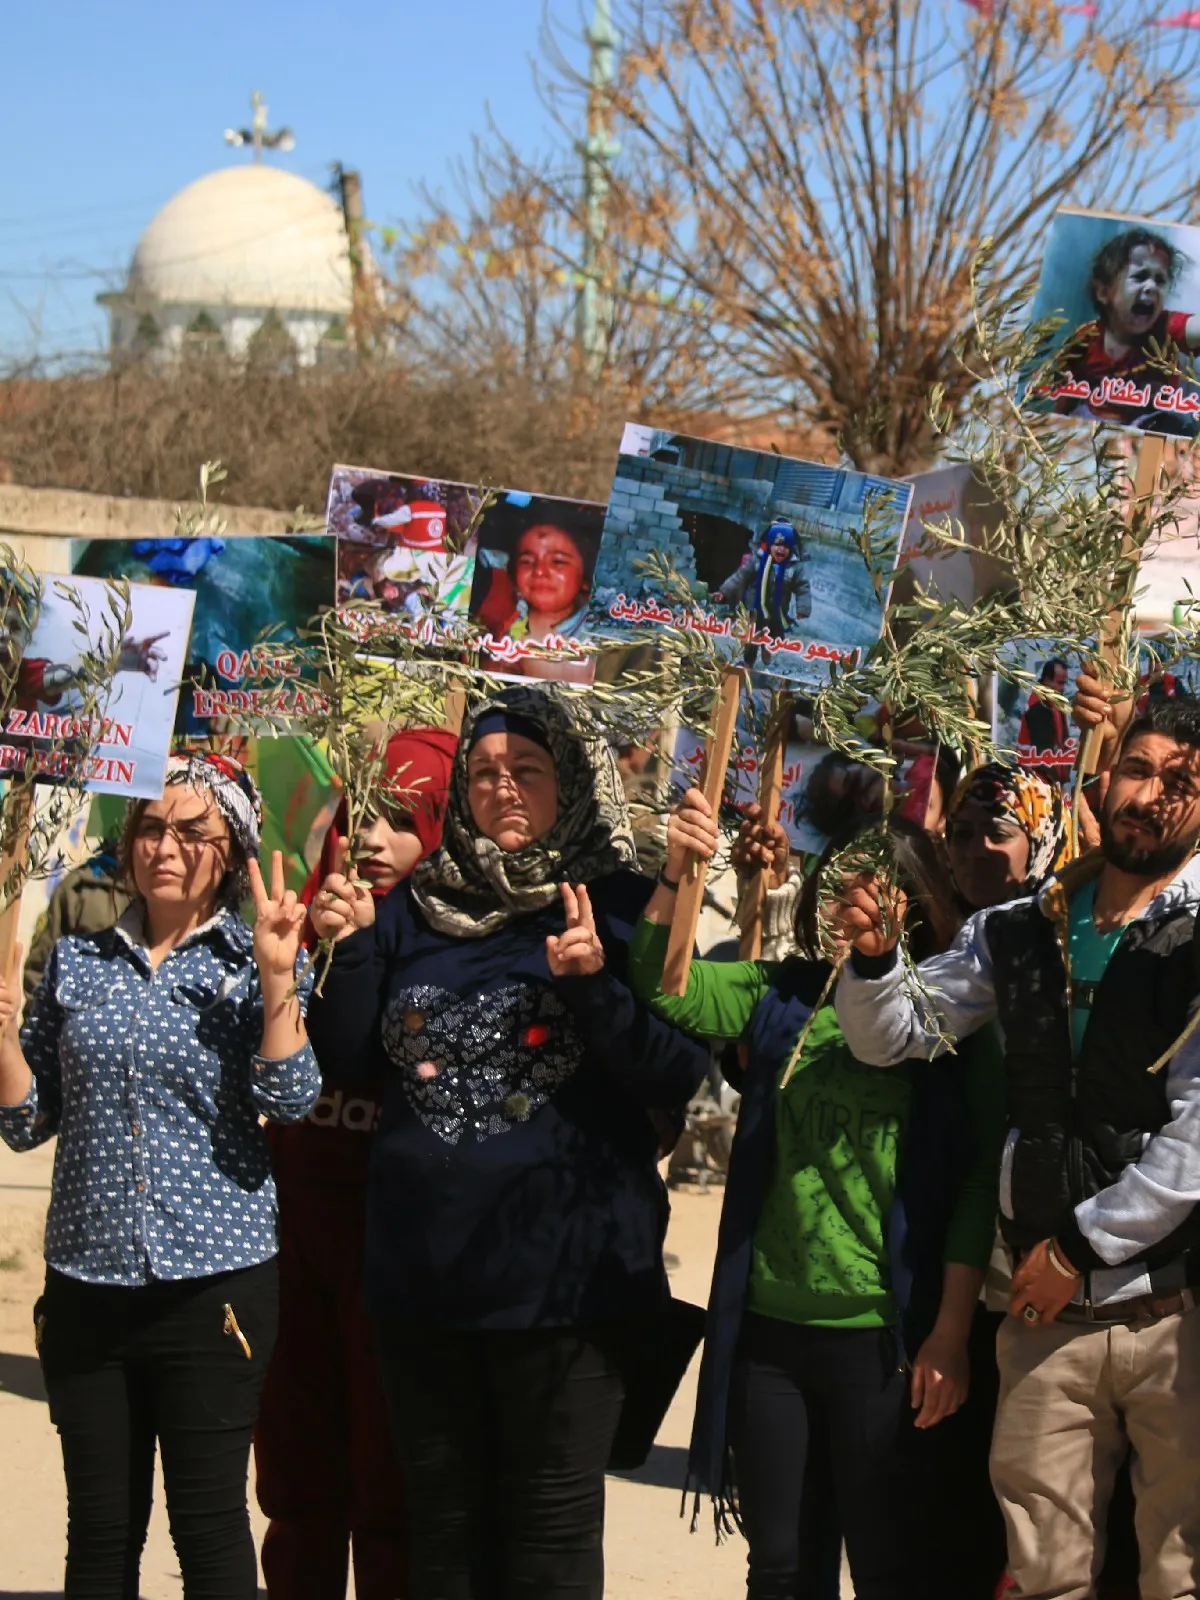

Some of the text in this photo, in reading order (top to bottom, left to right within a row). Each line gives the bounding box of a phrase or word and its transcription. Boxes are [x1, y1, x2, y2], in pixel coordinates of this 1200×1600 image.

[1091, 375, 1151, 407] اطفال
[610, 593, 673, 624] عفرين
[673, 608, 731, 637] اطفال
